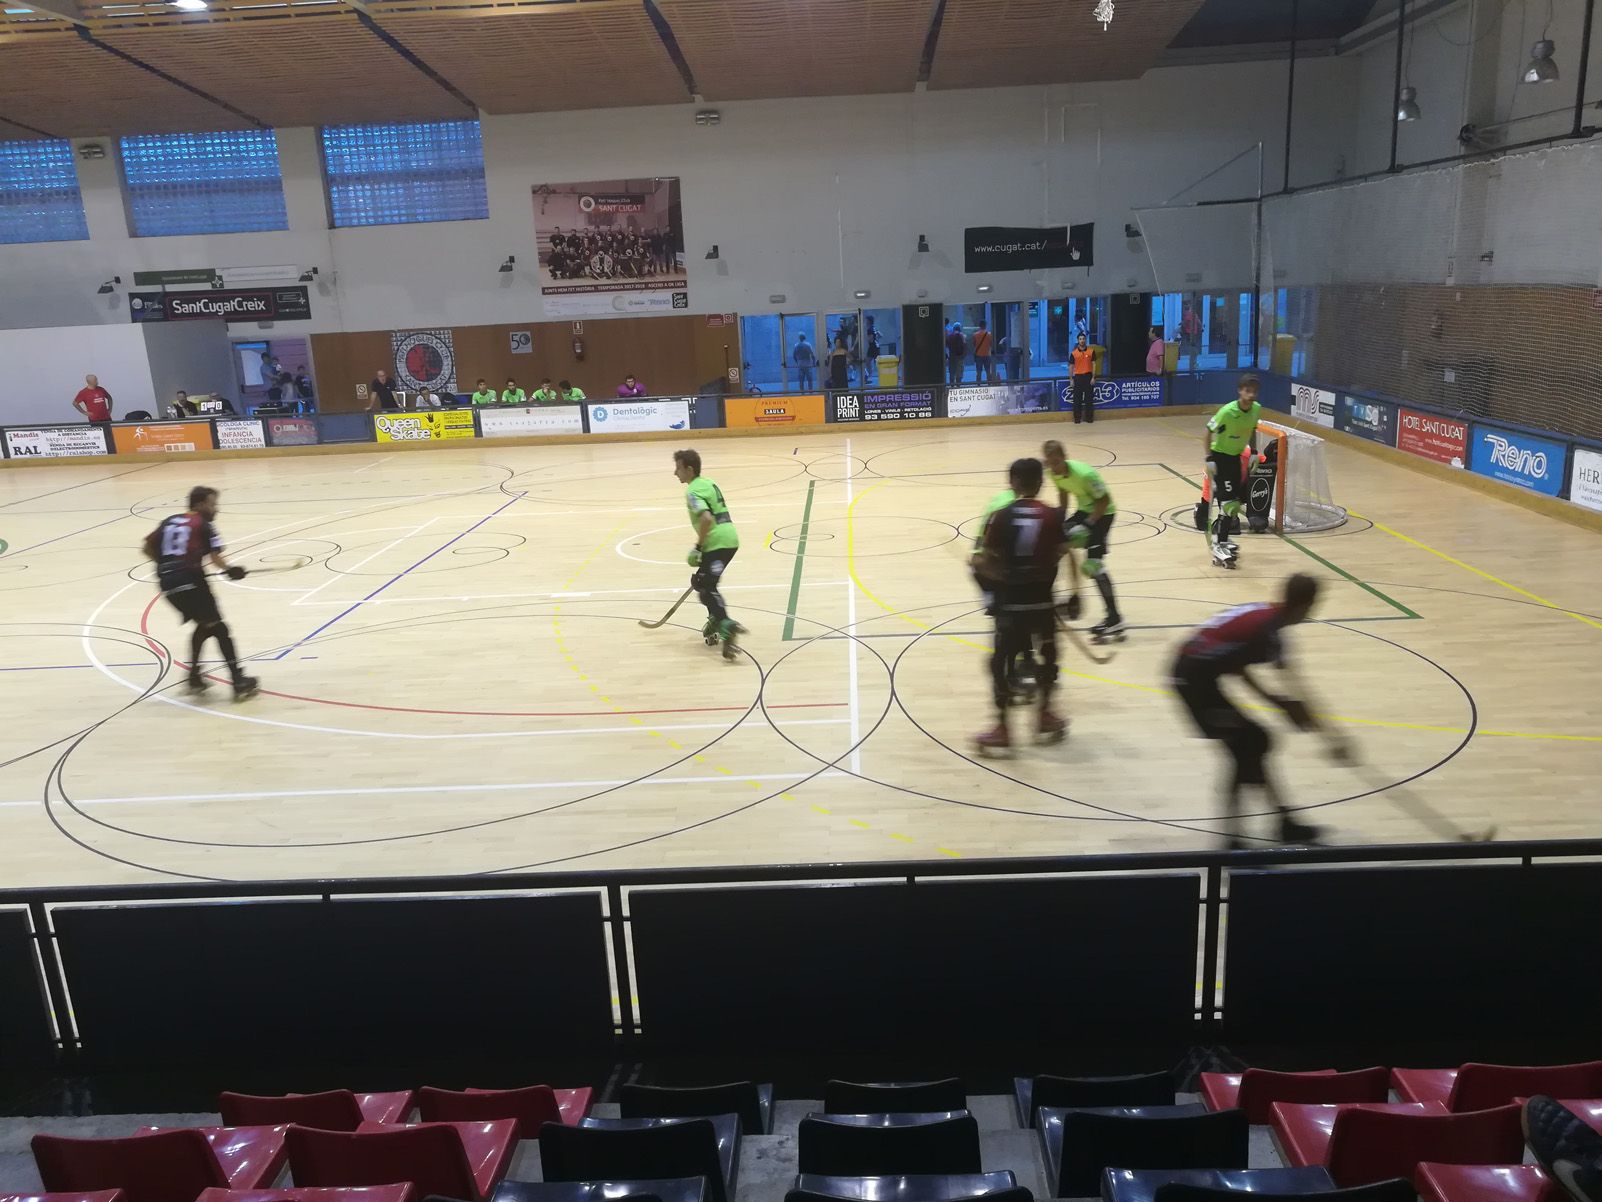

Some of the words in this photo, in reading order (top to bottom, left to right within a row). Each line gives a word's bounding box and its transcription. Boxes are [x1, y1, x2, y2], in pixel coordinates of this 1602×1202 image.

[598, 204, 617, 213] SANT
[618, 204, 641, 212] CUGAT
[172, 297, 266, 315] SantCugatCreix
[837, 395, 859, 409] IDEA
[864, 391, 931, 403] IMPRESSIÓ
[837, 407, 860, 418] PRINT
[376, 416, 421, 433] Queen
[1402, 415, 1420, 431] HOTEL
[1422, 419, 1439, 435] SANT
[1440, 423, 1464, 440] CUGAT
[390, 427, 431, 440] Skate
[12, 446, 42, 456] RAL
[1484, 434, 1547, 479] Reno
[1224, 480, 1233, 492] 5
[712, 483, 727, 508] 4
